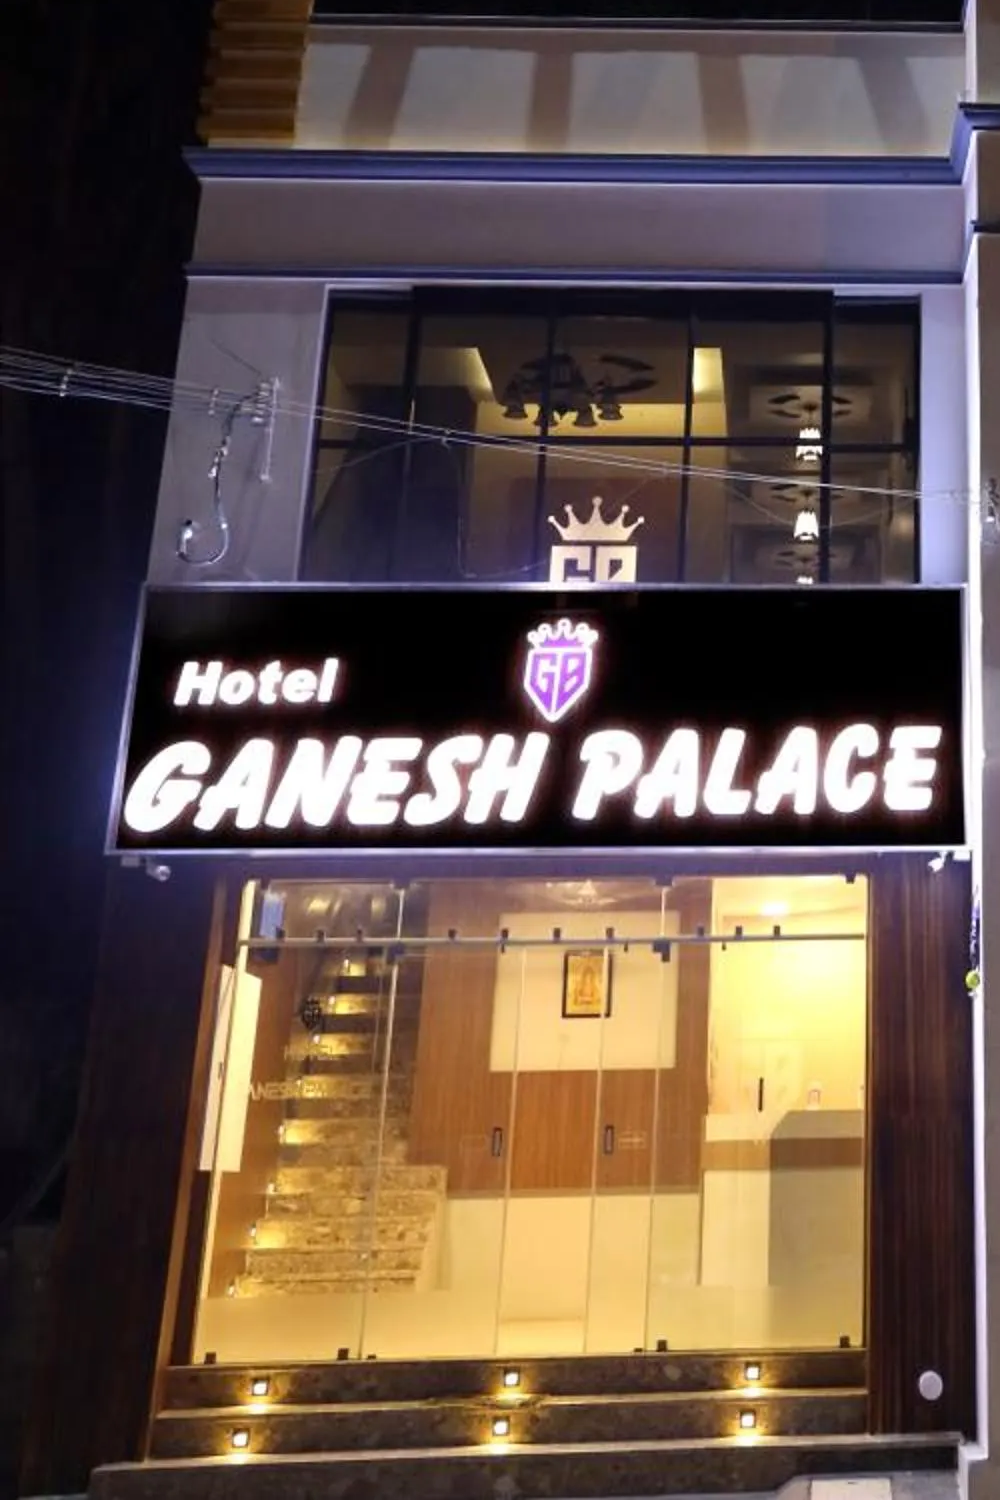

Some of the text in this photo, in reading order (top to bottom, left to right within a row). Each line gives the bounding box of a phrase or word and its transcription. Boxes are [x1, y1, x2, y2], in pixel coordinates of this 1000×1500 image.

[174, 657, 339, 706] Hotel
[123, 723, 943, 833] GANESH PALACE
